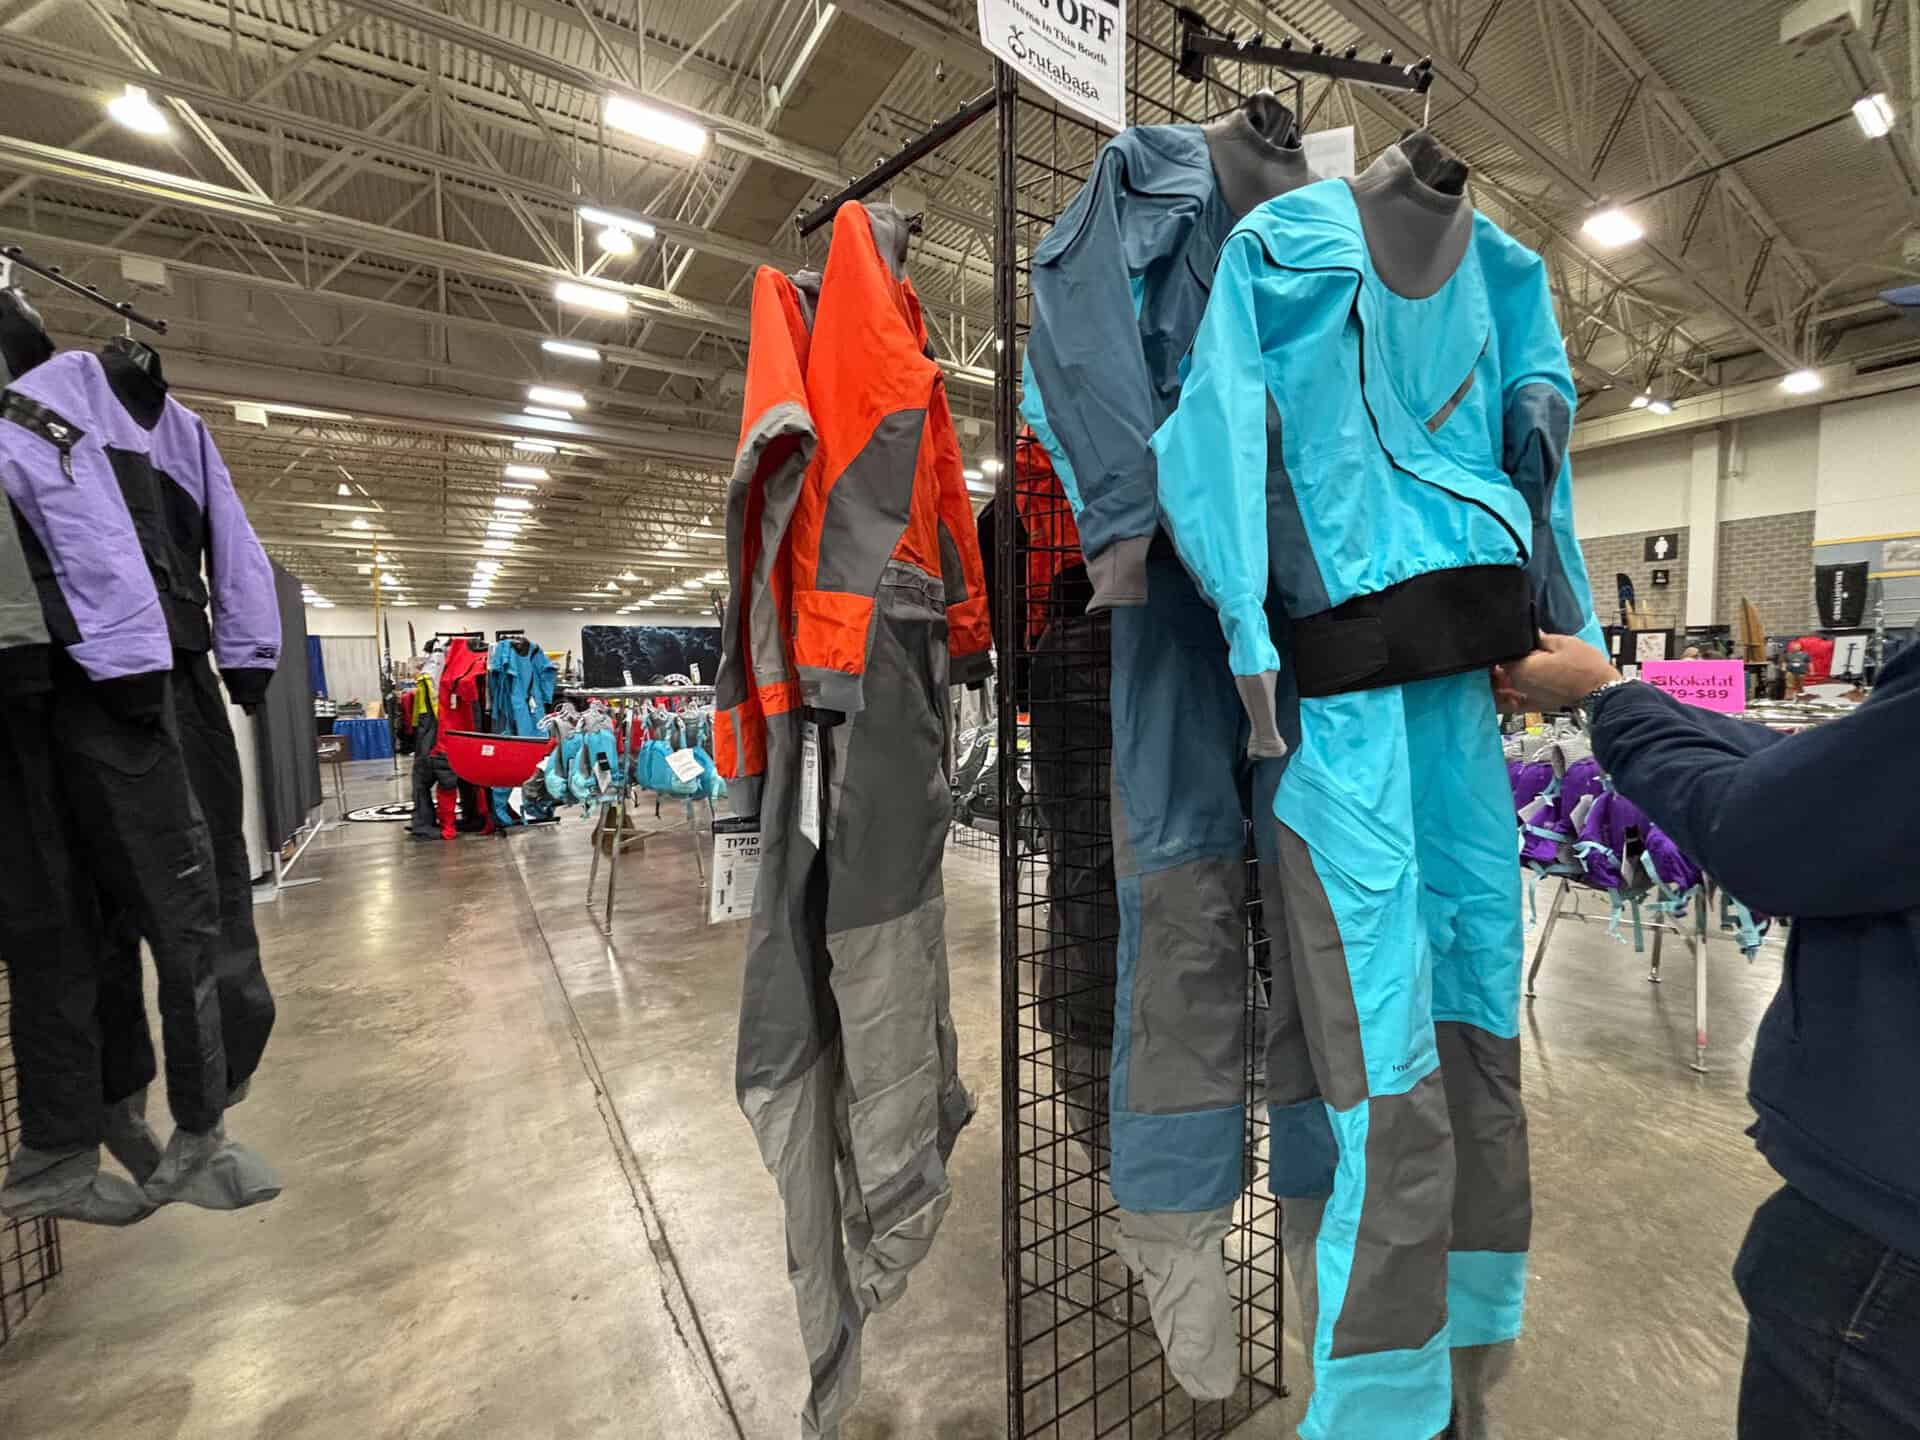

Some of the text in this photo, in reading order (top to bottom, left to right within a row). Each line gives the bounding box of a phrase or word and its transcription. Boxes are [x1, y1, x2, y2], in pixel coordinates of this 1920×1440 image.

[1056, 0, 1115, 44] OFF
[1053, 26, 1076, 49] This
[1077, 41, 1108, 66] Booth
[1028, 48, 1100, 102] rutabaga
[1667, 689, 1729, 699] 79-$89
